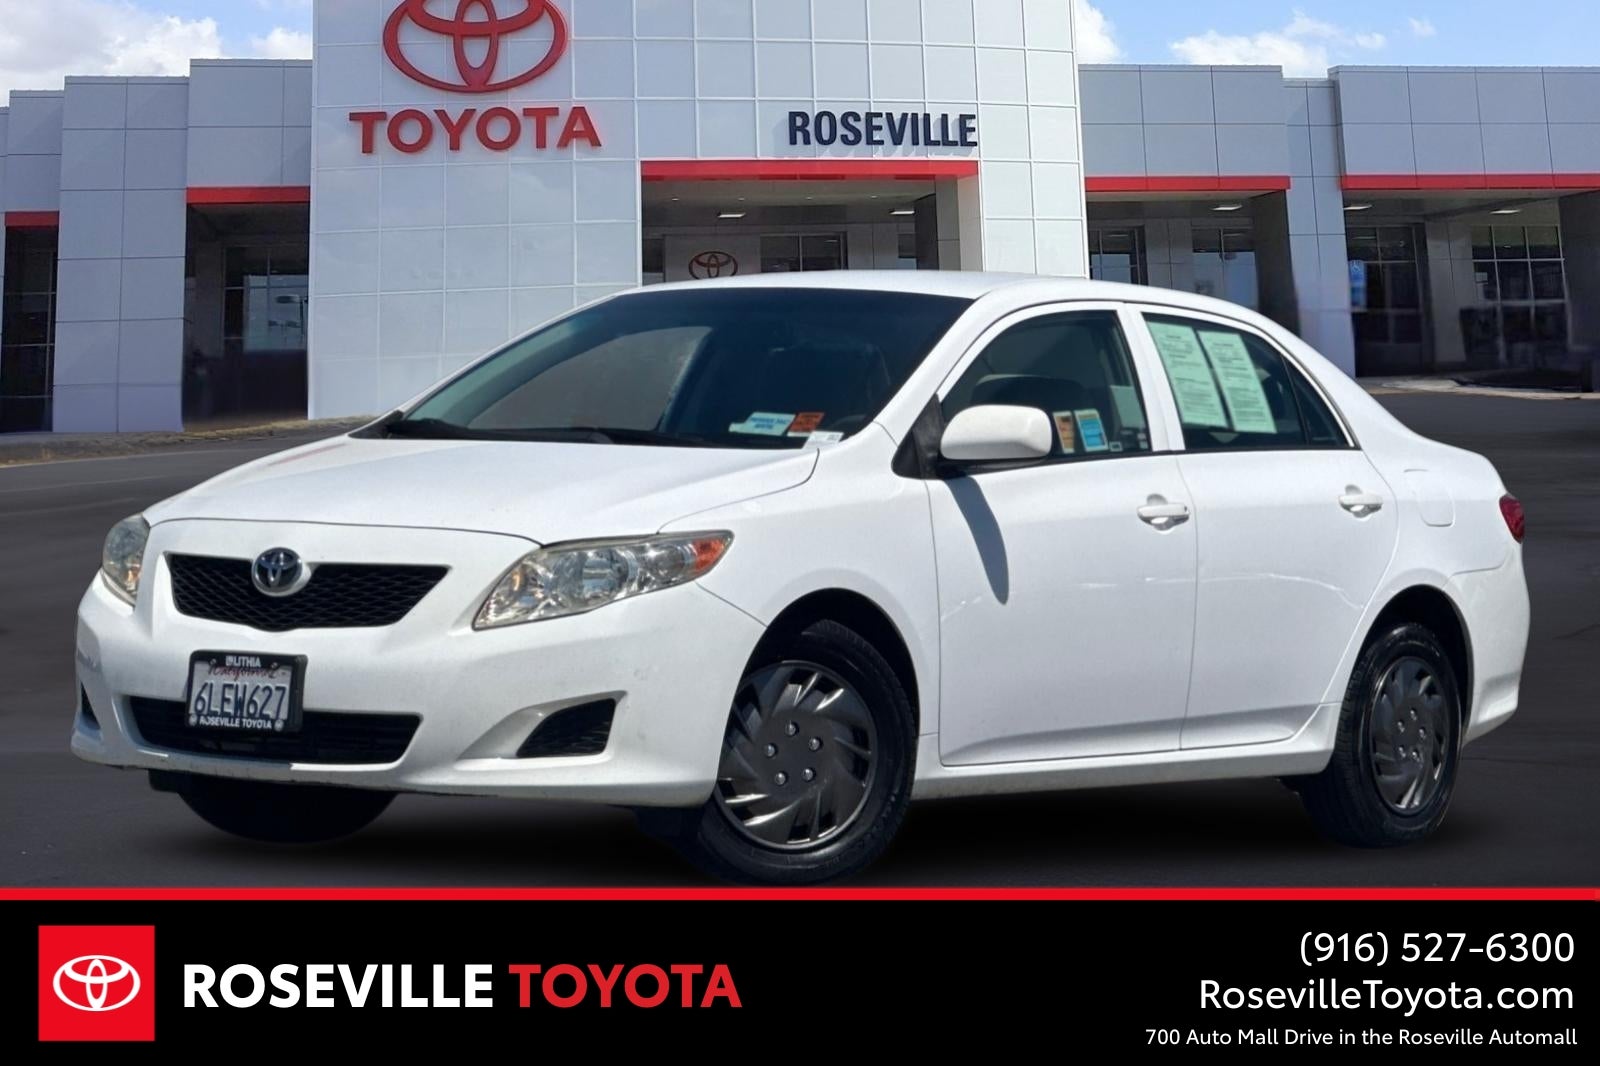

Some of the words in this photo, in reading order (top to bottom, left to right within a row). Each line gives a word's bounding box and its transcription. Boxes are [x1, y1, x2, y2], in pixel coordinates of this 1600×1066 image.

[349, 106, 602, 154] TOYOTA
[788, 110, 978, 147] ROSEVILLE
[194, 681, 287, 719] 6LEW627
[242, 718, 272, 729] TOYOTA
